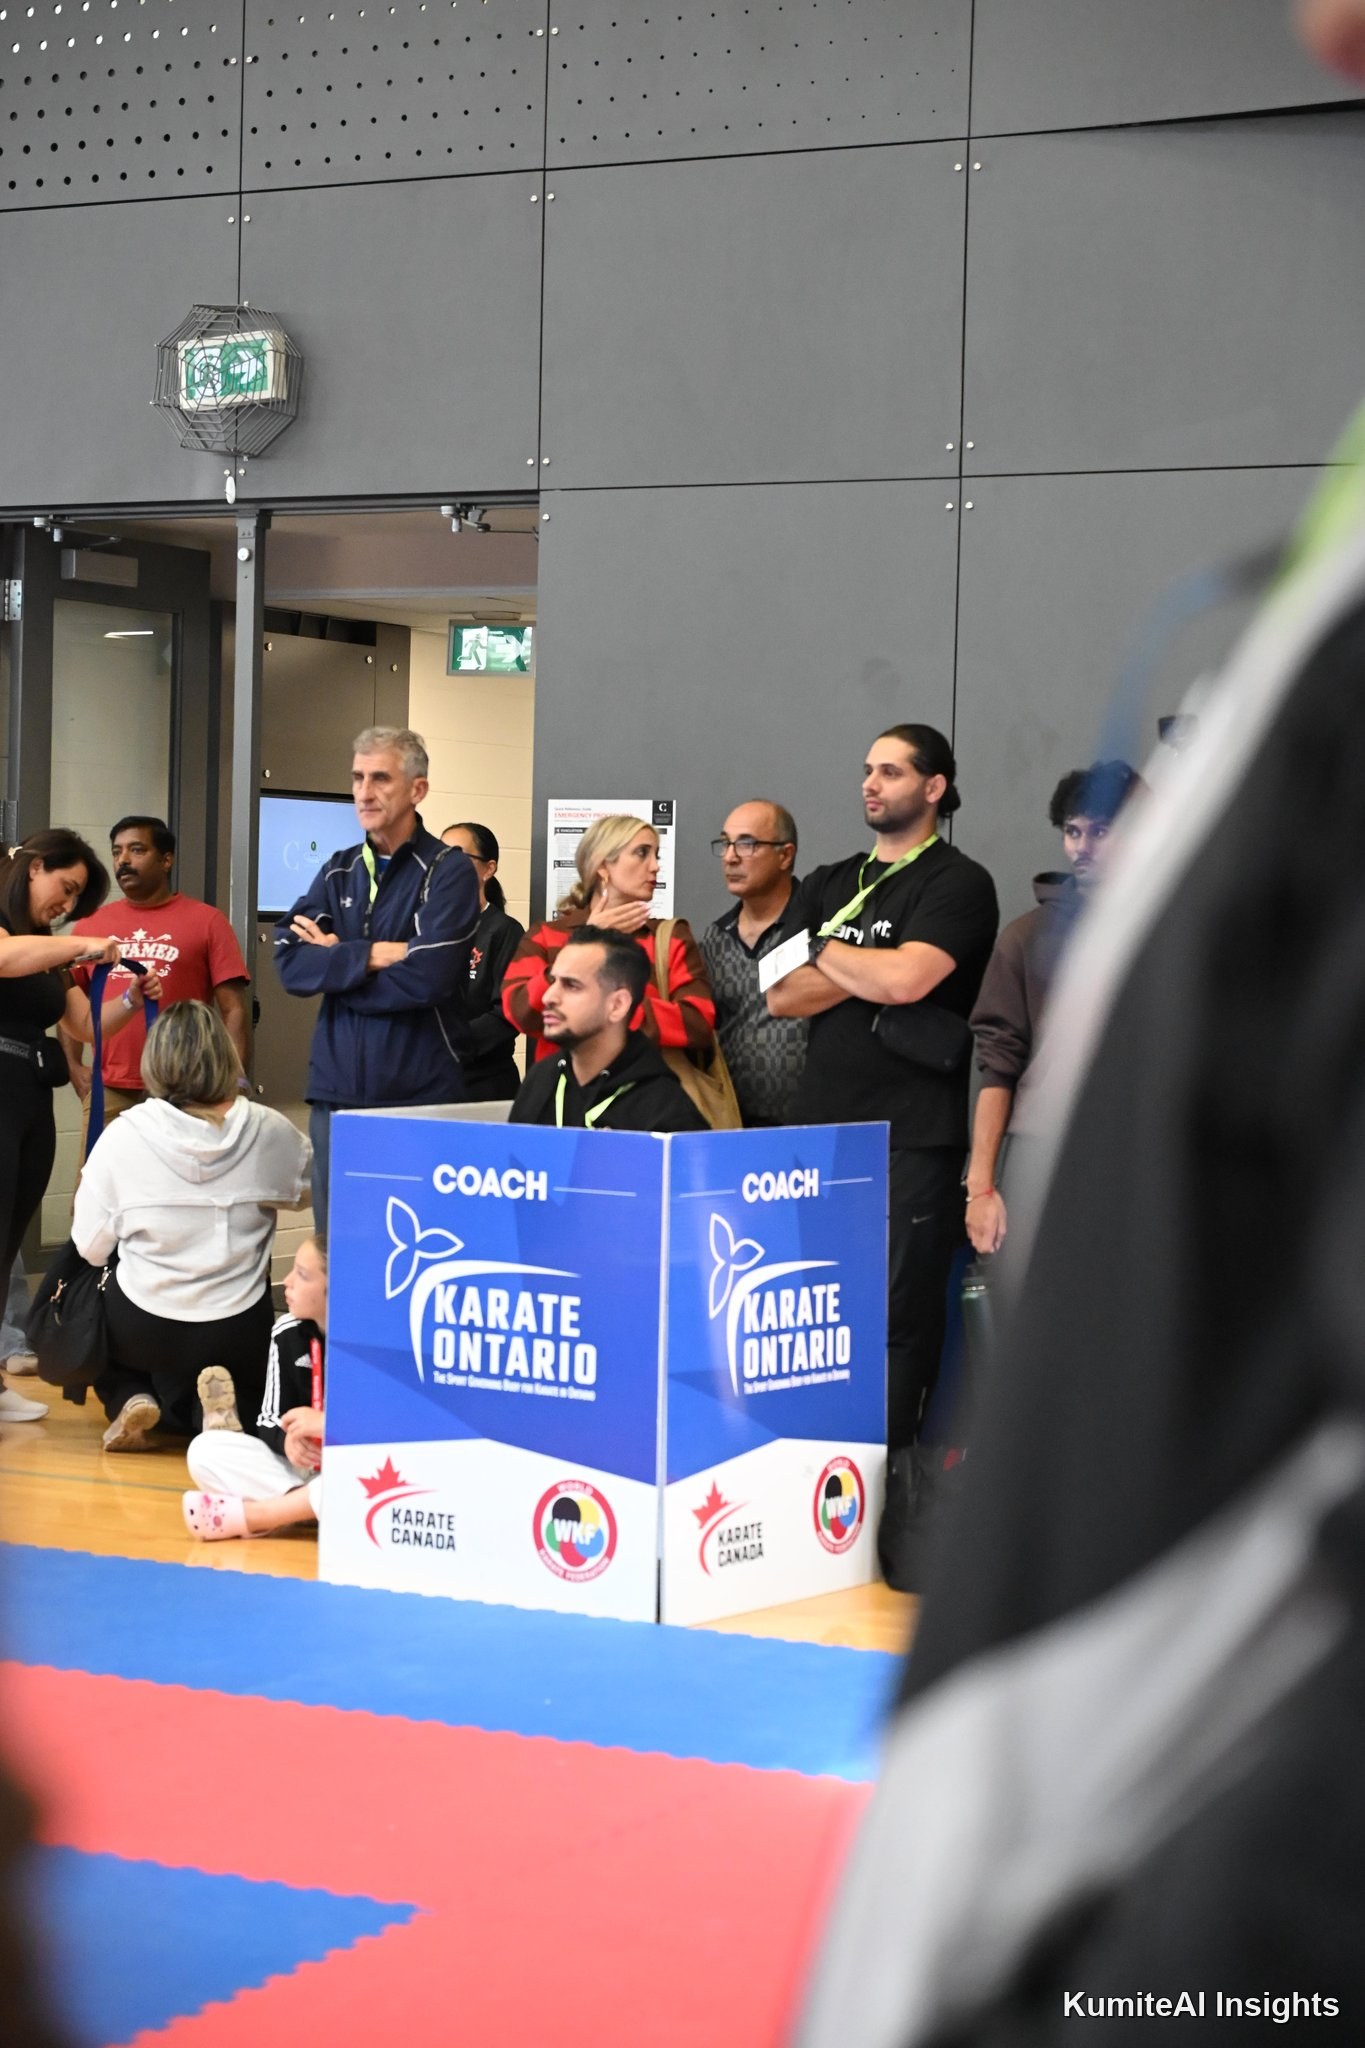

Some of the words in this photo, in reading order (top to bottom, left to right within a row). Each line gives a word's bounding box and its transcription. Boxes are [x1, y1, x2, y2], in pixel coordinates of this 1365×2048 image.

[658, 803, 667, 813] C
[116, 943, 179, 963] TAMED
[433, 1164, 548, 1201] COACH
[742, 1169, 819, 1203] COACH
[433, 1283, 581, 1337] KARATE
[743, 1284, 841, 1334] KARATE
[433, 1329, 597, 1385] ONTARIO
[743, 1326, 851, 1379] ONTARIO
[392, 1507, 455, 1531] KARATE
[825, 1496, 852, 1519] WKF
[392, 1527, 456, 1551] CANADA
[553, 1517, 596, 1546] WKF
[718, 1521, 762, 1547] KARATE
[718, 1542, 763, 1567] CANADA
